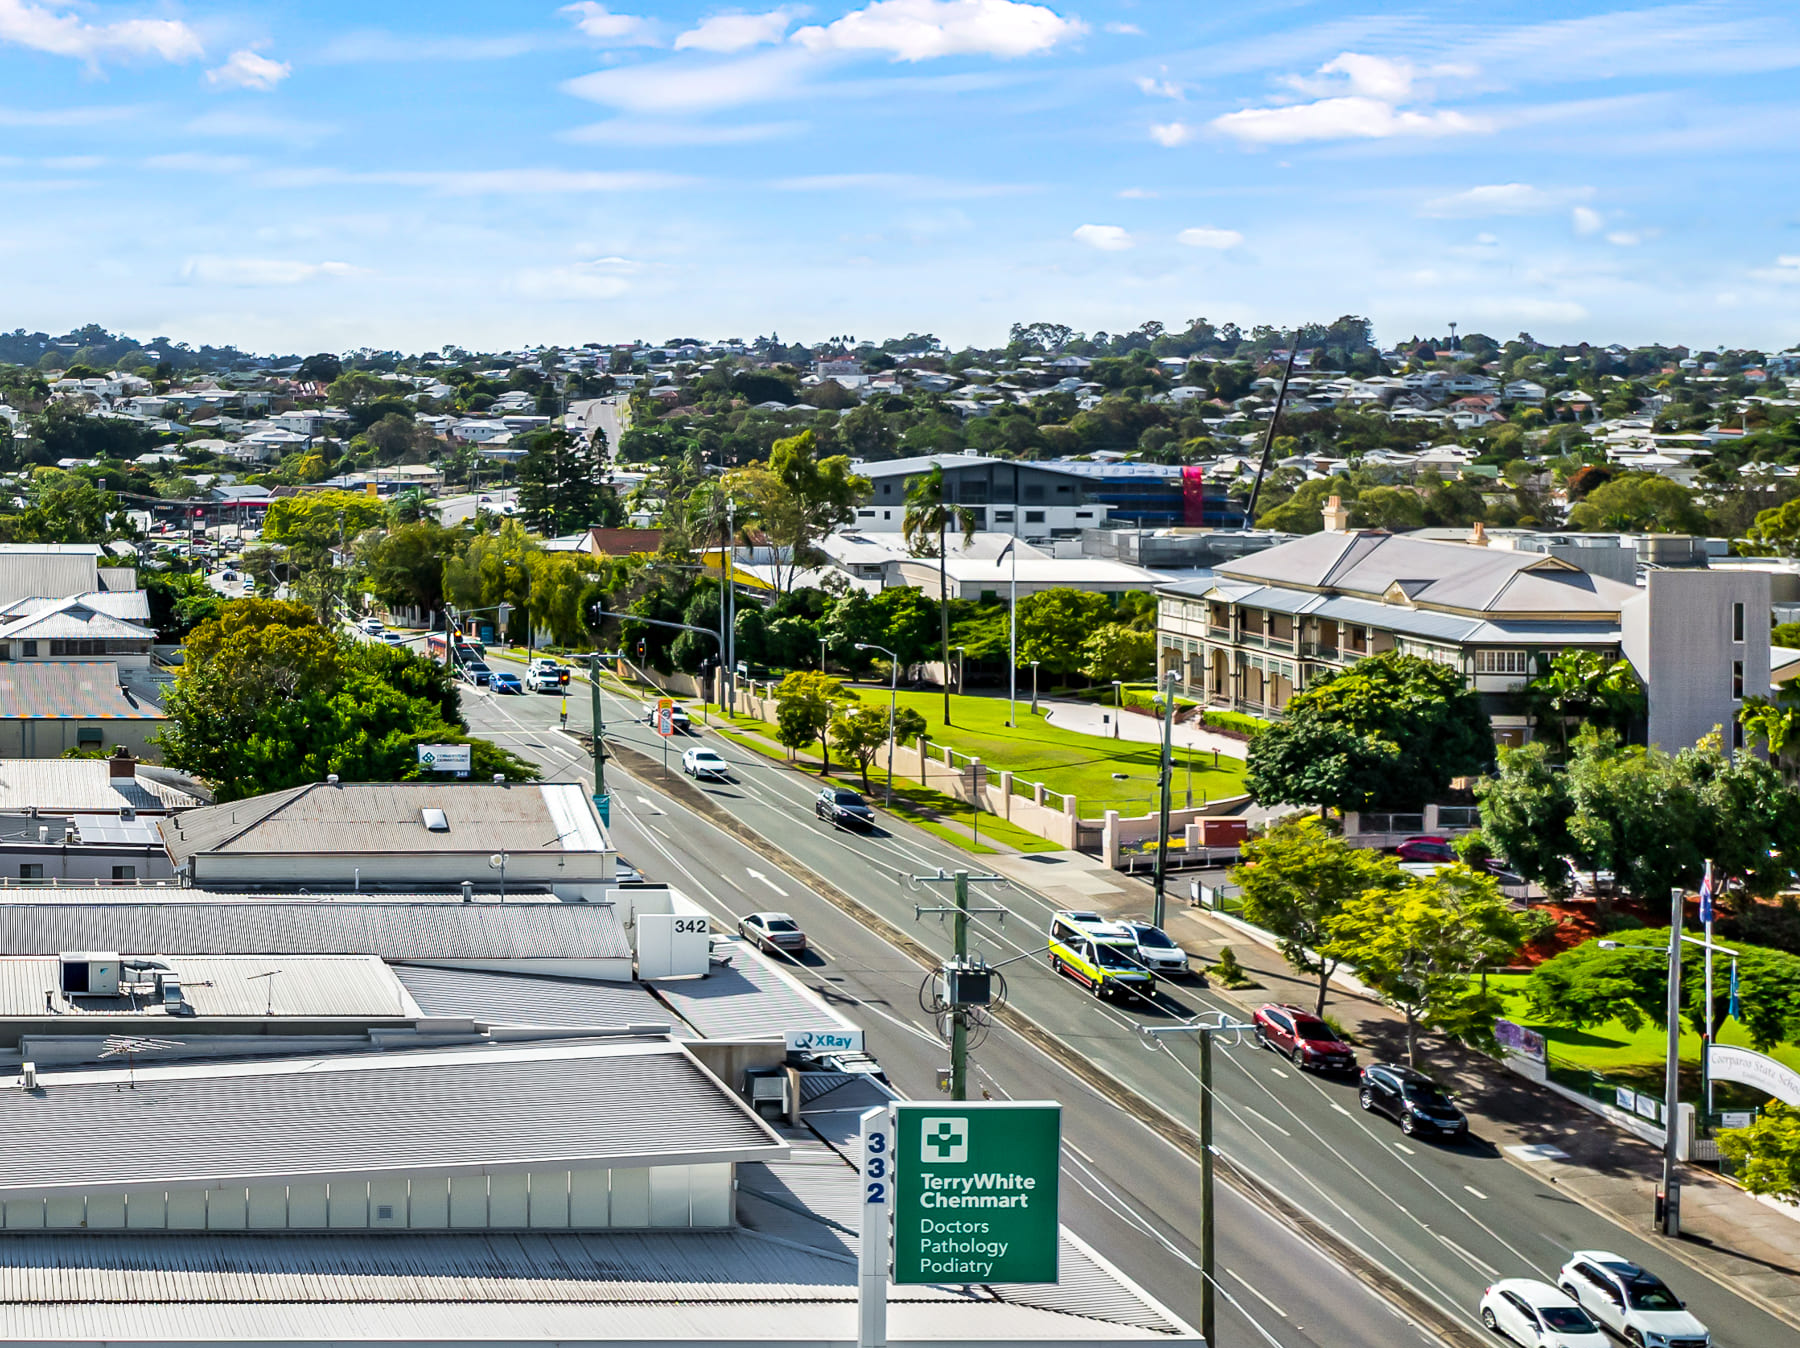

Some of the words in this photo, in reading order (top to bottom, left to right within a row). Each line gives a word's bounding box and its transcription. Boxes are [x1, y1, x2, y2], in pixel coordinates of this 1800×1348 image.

[675, 919, 707, 933] 342
[920, 1173, 1036, 1194] TerryWhite
[920, 1192, 1029, 1208] Chemmart
[920, 1219, 990, 1234] Doctors
[920, 1238, 1009, 1257] Pathology
[920, 1258, 994, 1276] Podiatry
